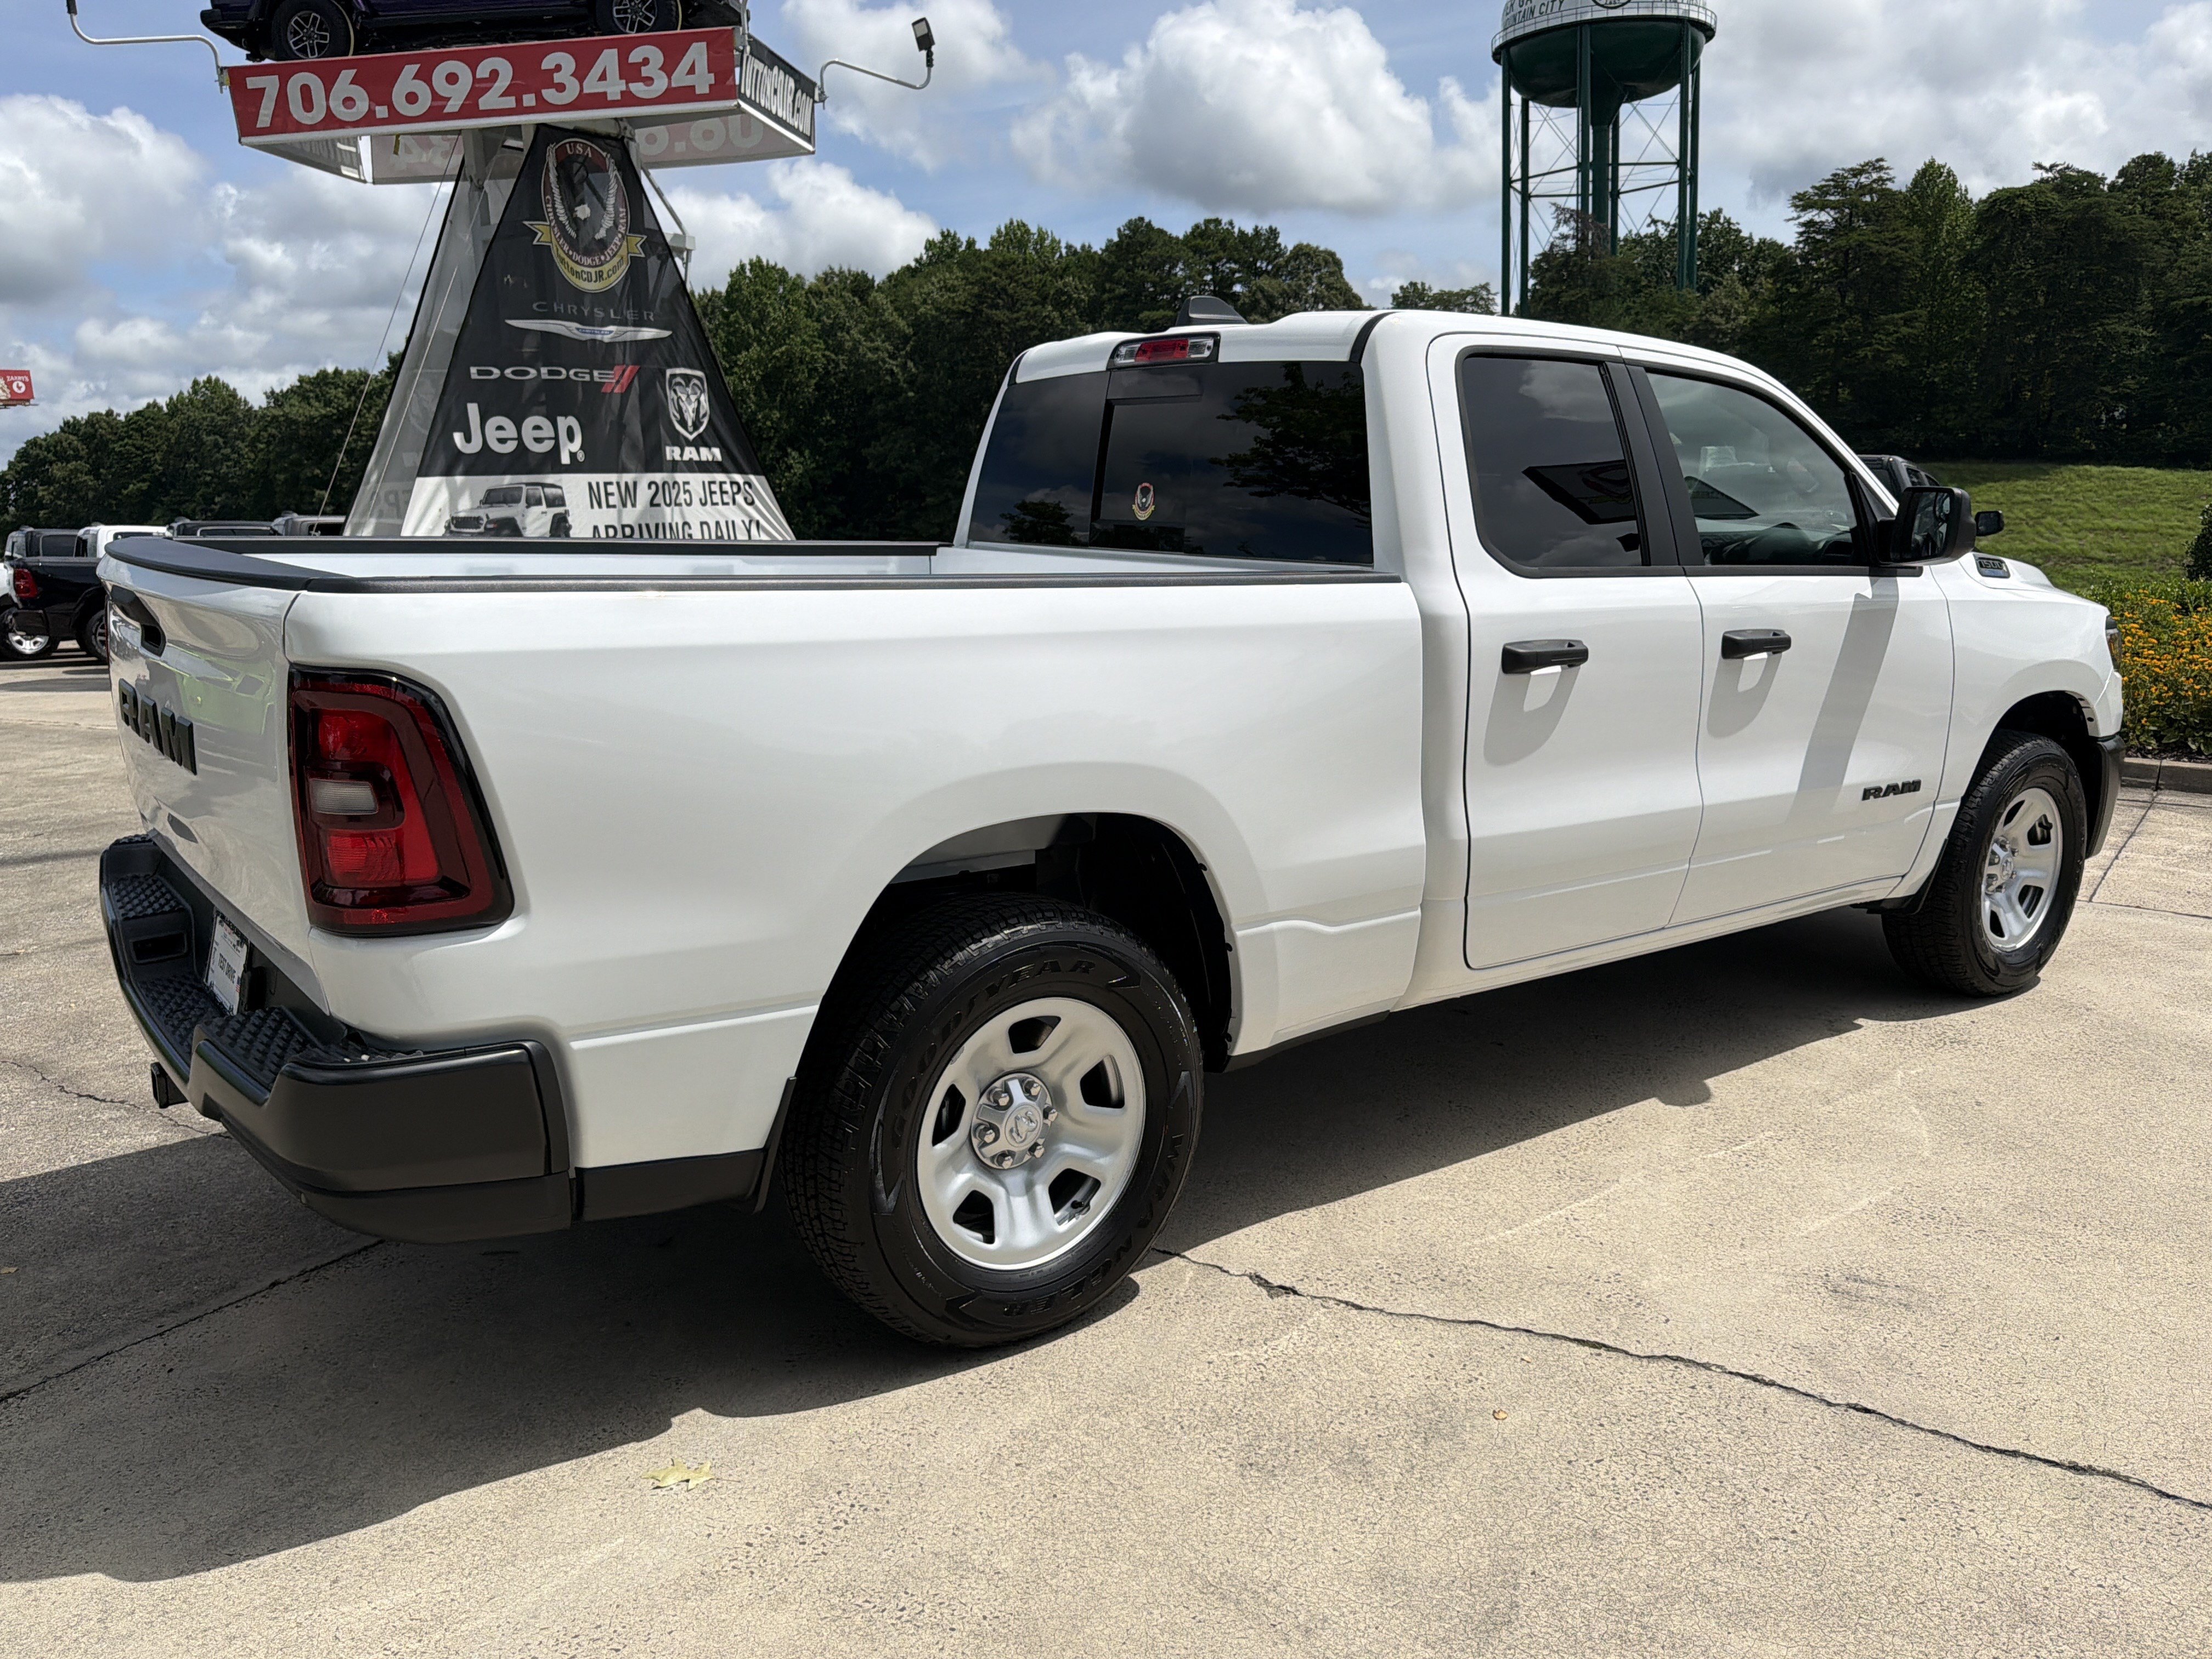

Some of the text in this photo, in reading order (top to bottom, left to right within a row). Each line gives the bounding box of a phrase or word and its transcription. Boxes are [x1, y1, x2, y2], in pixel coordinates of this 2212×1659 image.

[1539, 0, 1564, 15] CITY
[246, 42, 714, 128] 706.692.3434
[566, 144, 592, 157] USA
[572, 251, 601, 266] DODGE
[604, 236, 621, 261] JEEP
[532, 302, 654, 321] CHRYSLER
[470, 366, 616, 382] DODGE
[665, 446, 723, 461] RAM
[588, 481, 755, 509] NEW 2025 JEEPS
[119, 678, 197, 776] RAM
[1861, 779, 1921, 801] RAM
